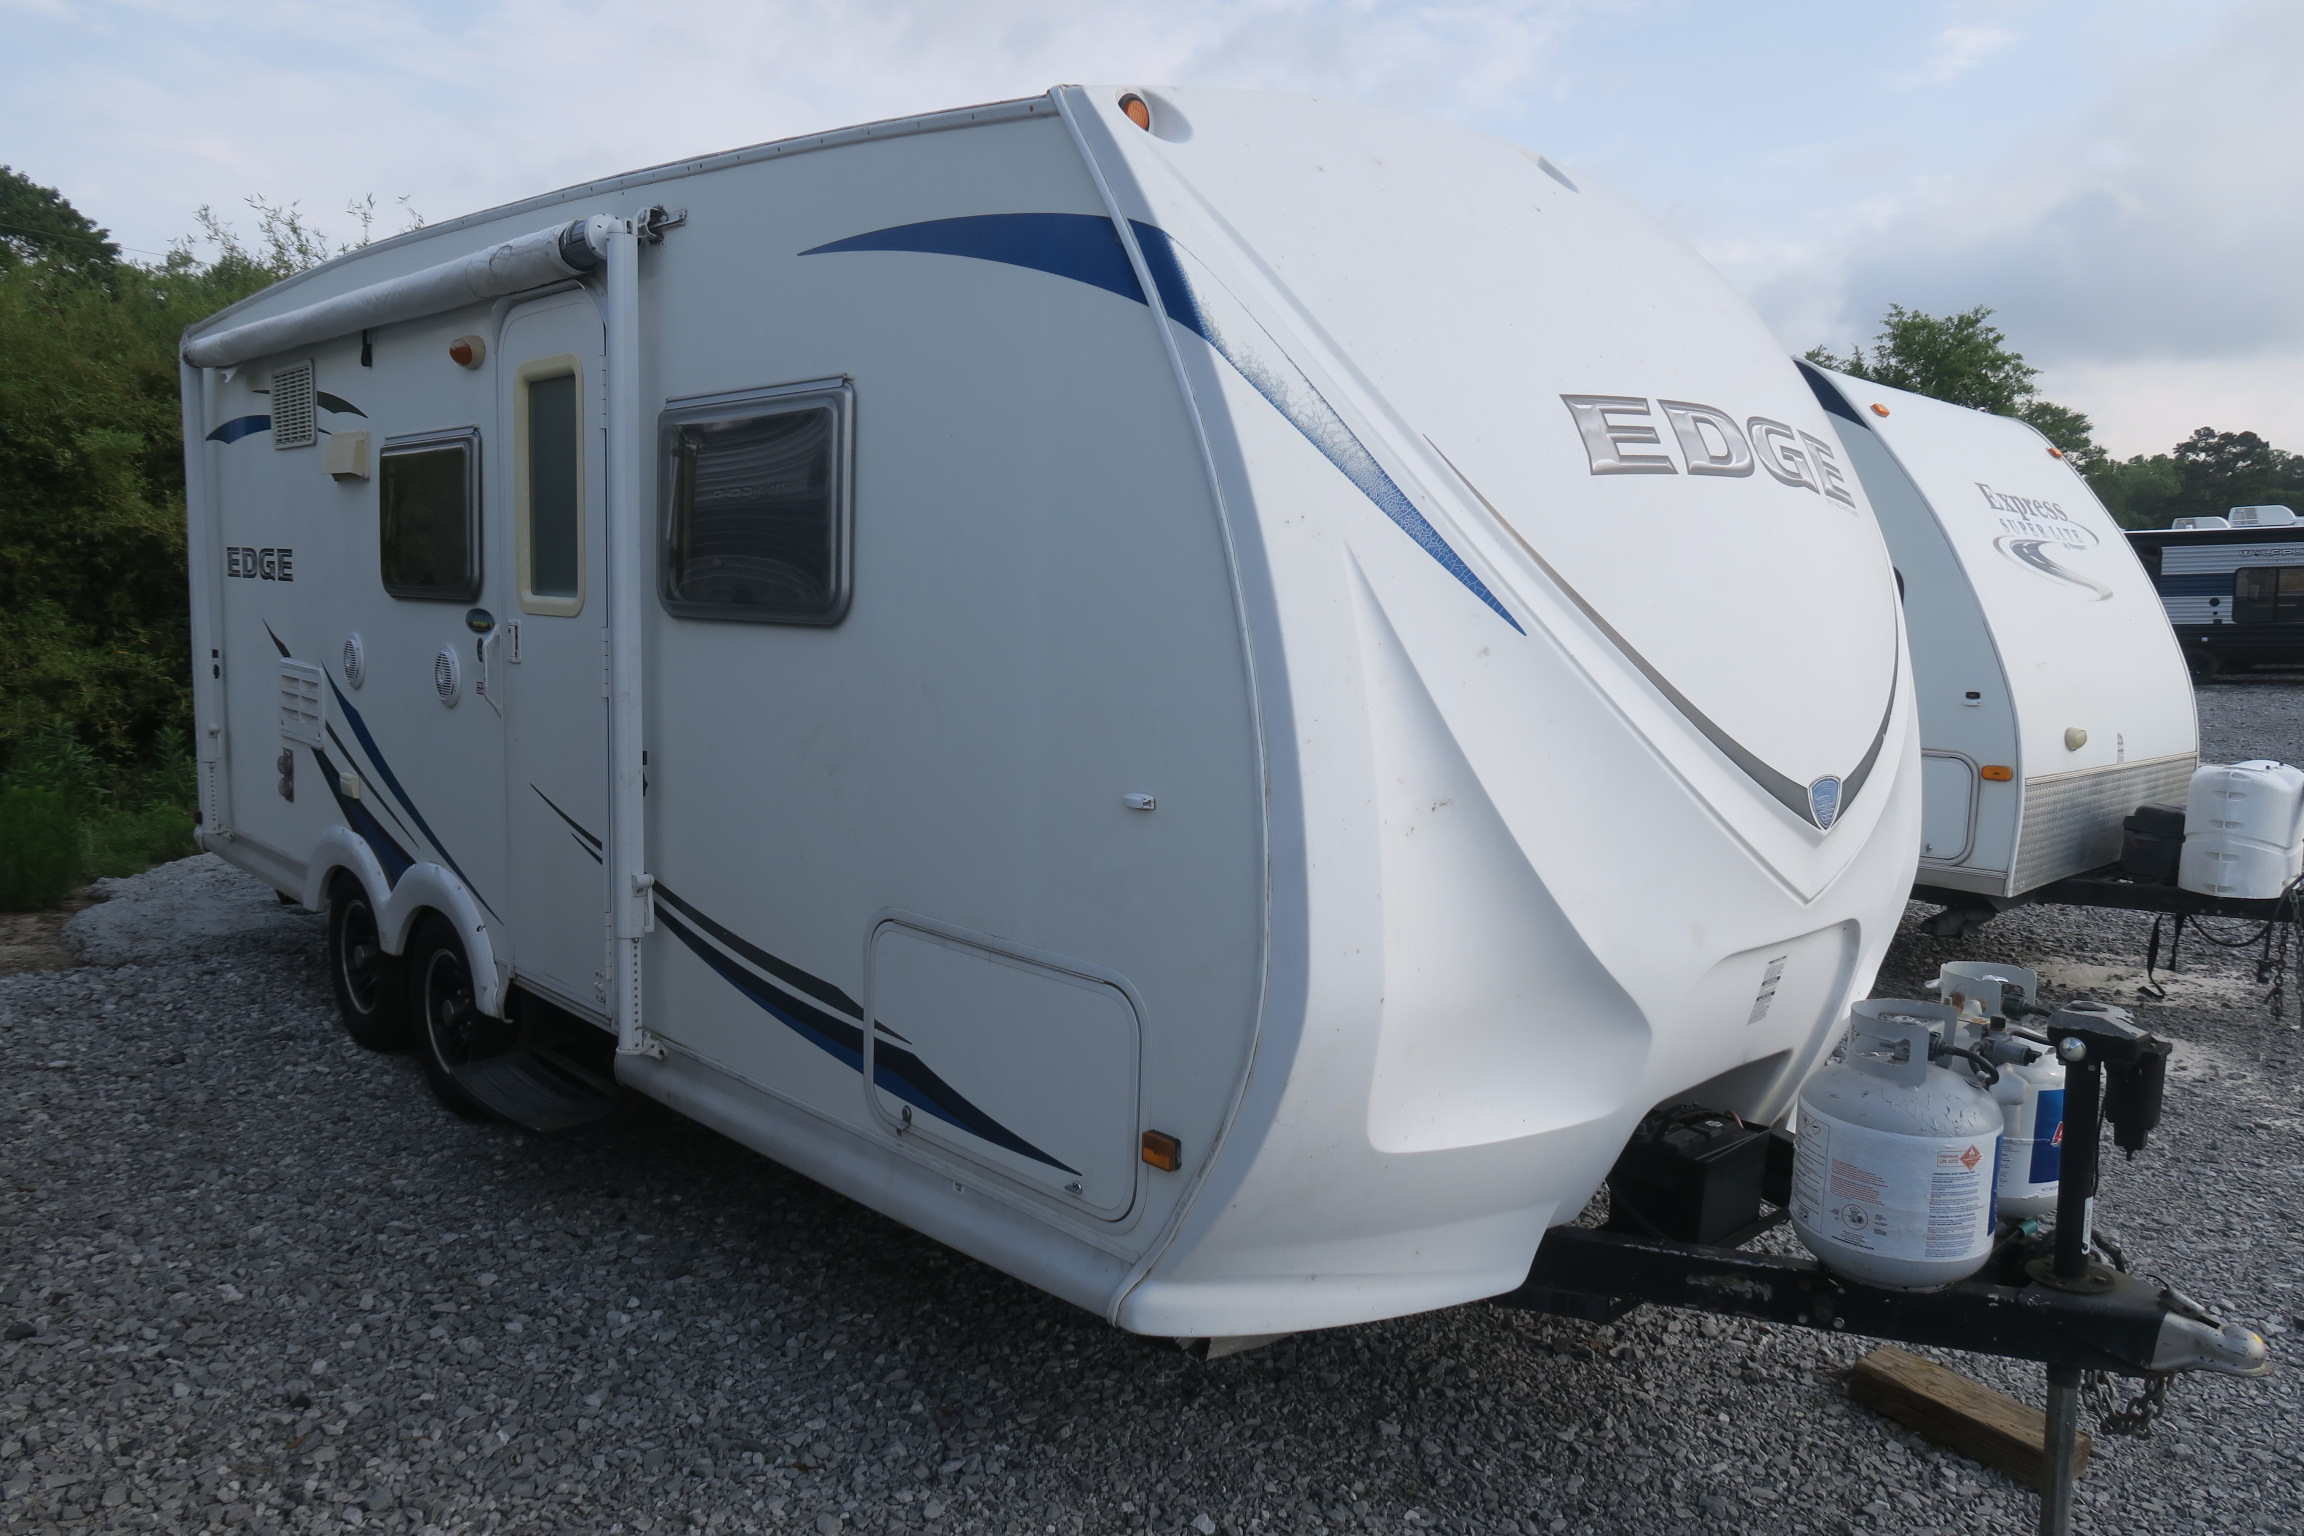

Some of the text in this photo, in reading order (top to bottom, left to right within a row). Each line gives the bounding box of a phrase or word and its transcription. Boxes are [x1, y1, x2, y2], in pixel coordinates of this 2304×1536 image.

[1559, 394, 1856, 509] EDGE
[1974, 482, 2069, 522] Express
[1999, 518, 2085, 544] SUPER LITE
[226, 546, 294, 582] EDGE
[2281, 547, 2304, 556] PU
